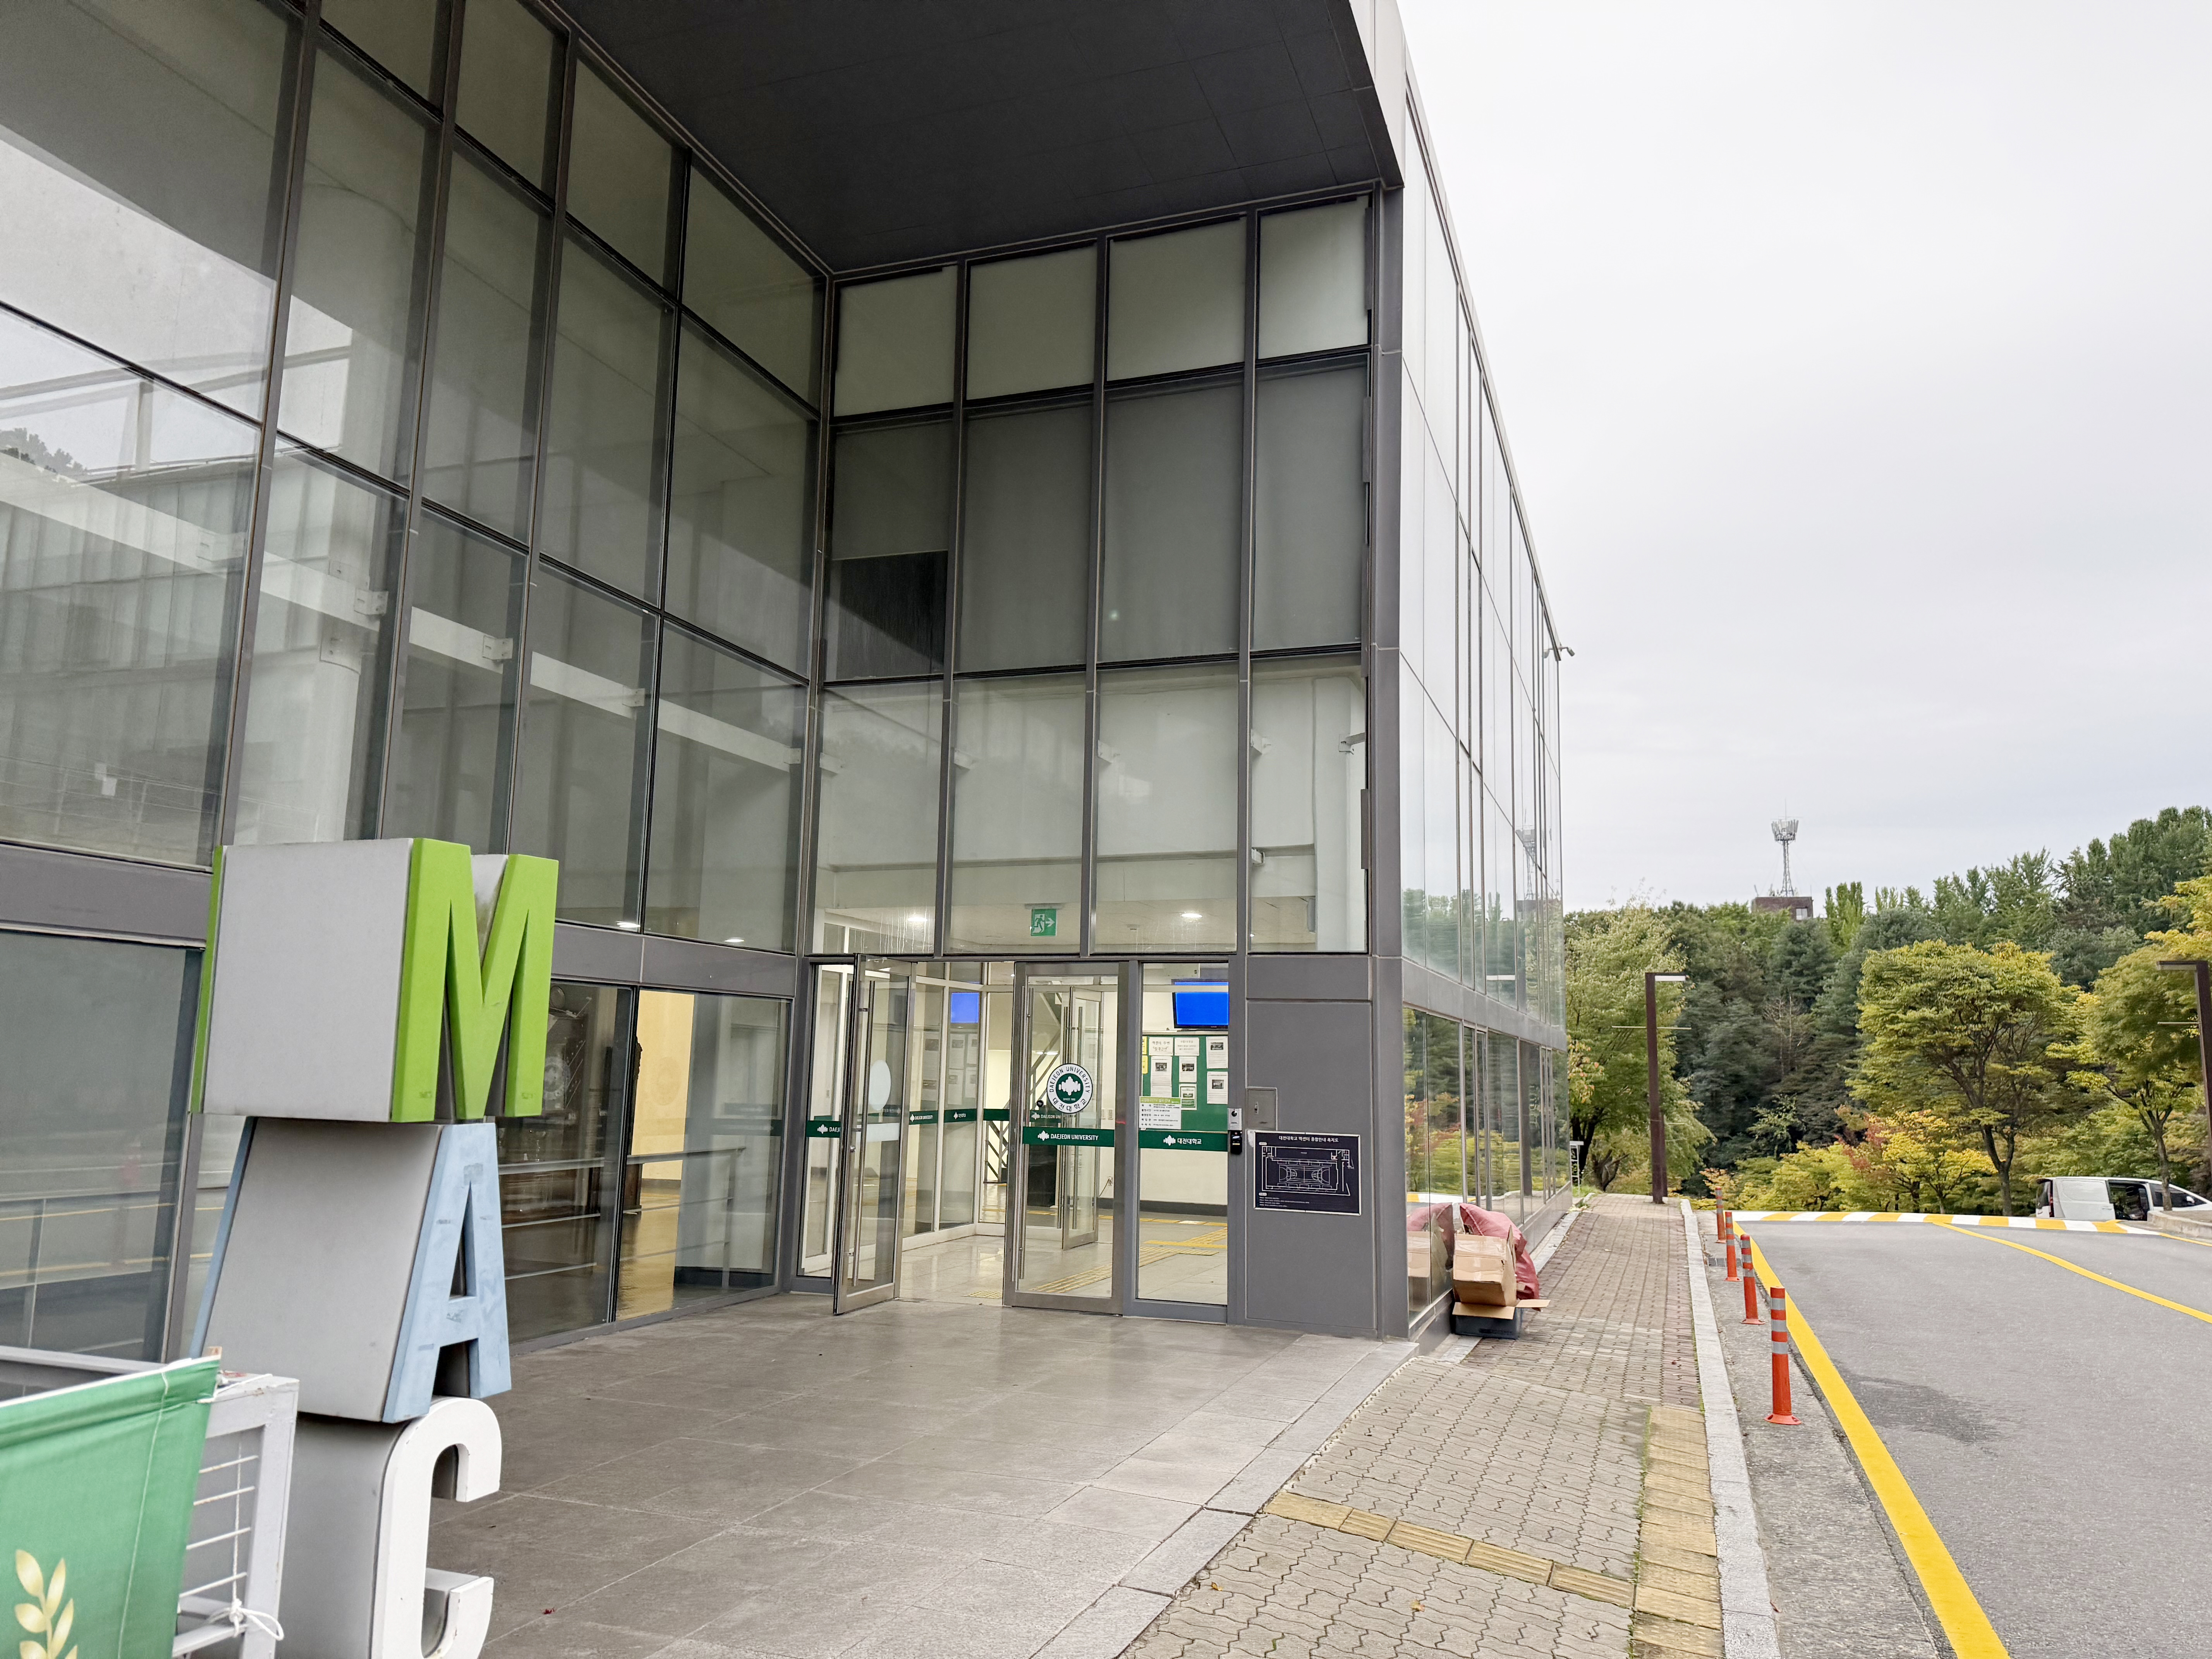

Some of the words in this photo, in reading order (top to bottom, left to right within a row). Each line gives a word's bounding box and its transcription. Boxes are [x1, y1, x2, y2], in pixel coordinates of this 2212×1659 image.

[1049, 1068, 1063, 1092] DAEJEON
[1066, 1066, 1091, 1094] UNIVERSITY
[1053, 1098, 1087, 1111] 대전대학교
